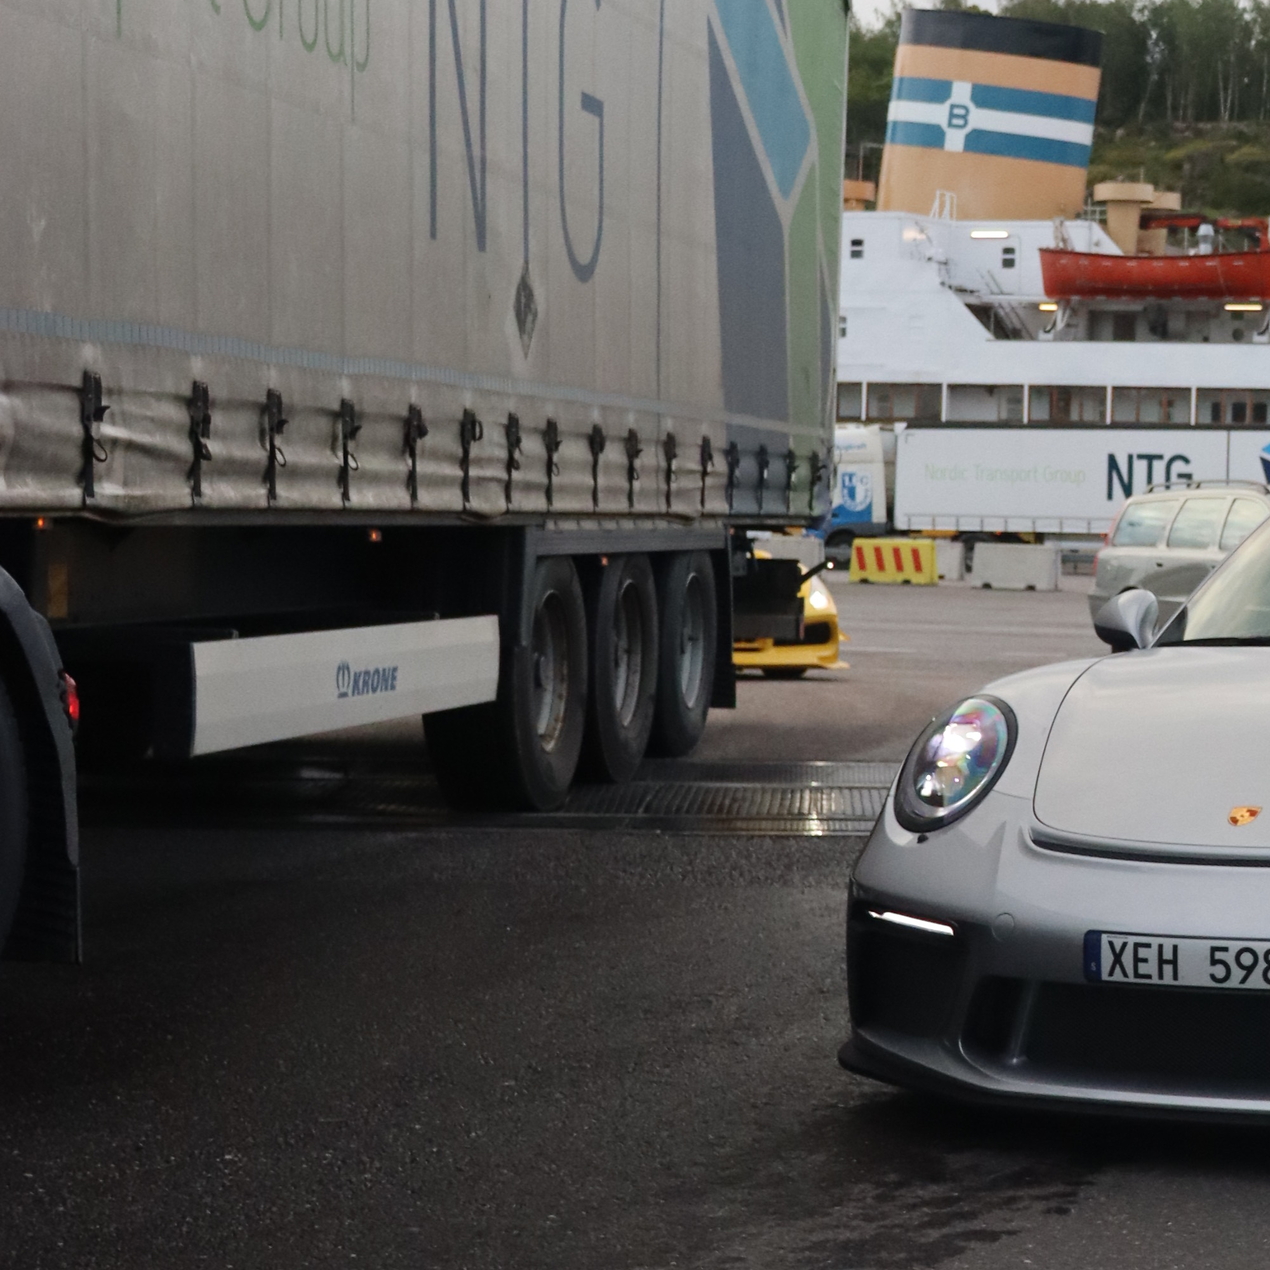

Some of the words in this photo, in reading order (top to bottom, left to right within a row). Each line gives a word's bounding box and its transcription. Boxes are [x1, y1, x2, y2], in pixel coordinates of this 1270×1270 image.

[947, 103, 970, 129] B
[924, 462, 967, 481] Nordic
[973, 463, 1038, 486] Transport
[1043, 464, 1086, 487] Group
[1106, 452, 1194, 501] NTG
[351, 665, 398, 697] KRONE
[1107, 940, 1179, 981] XEH
